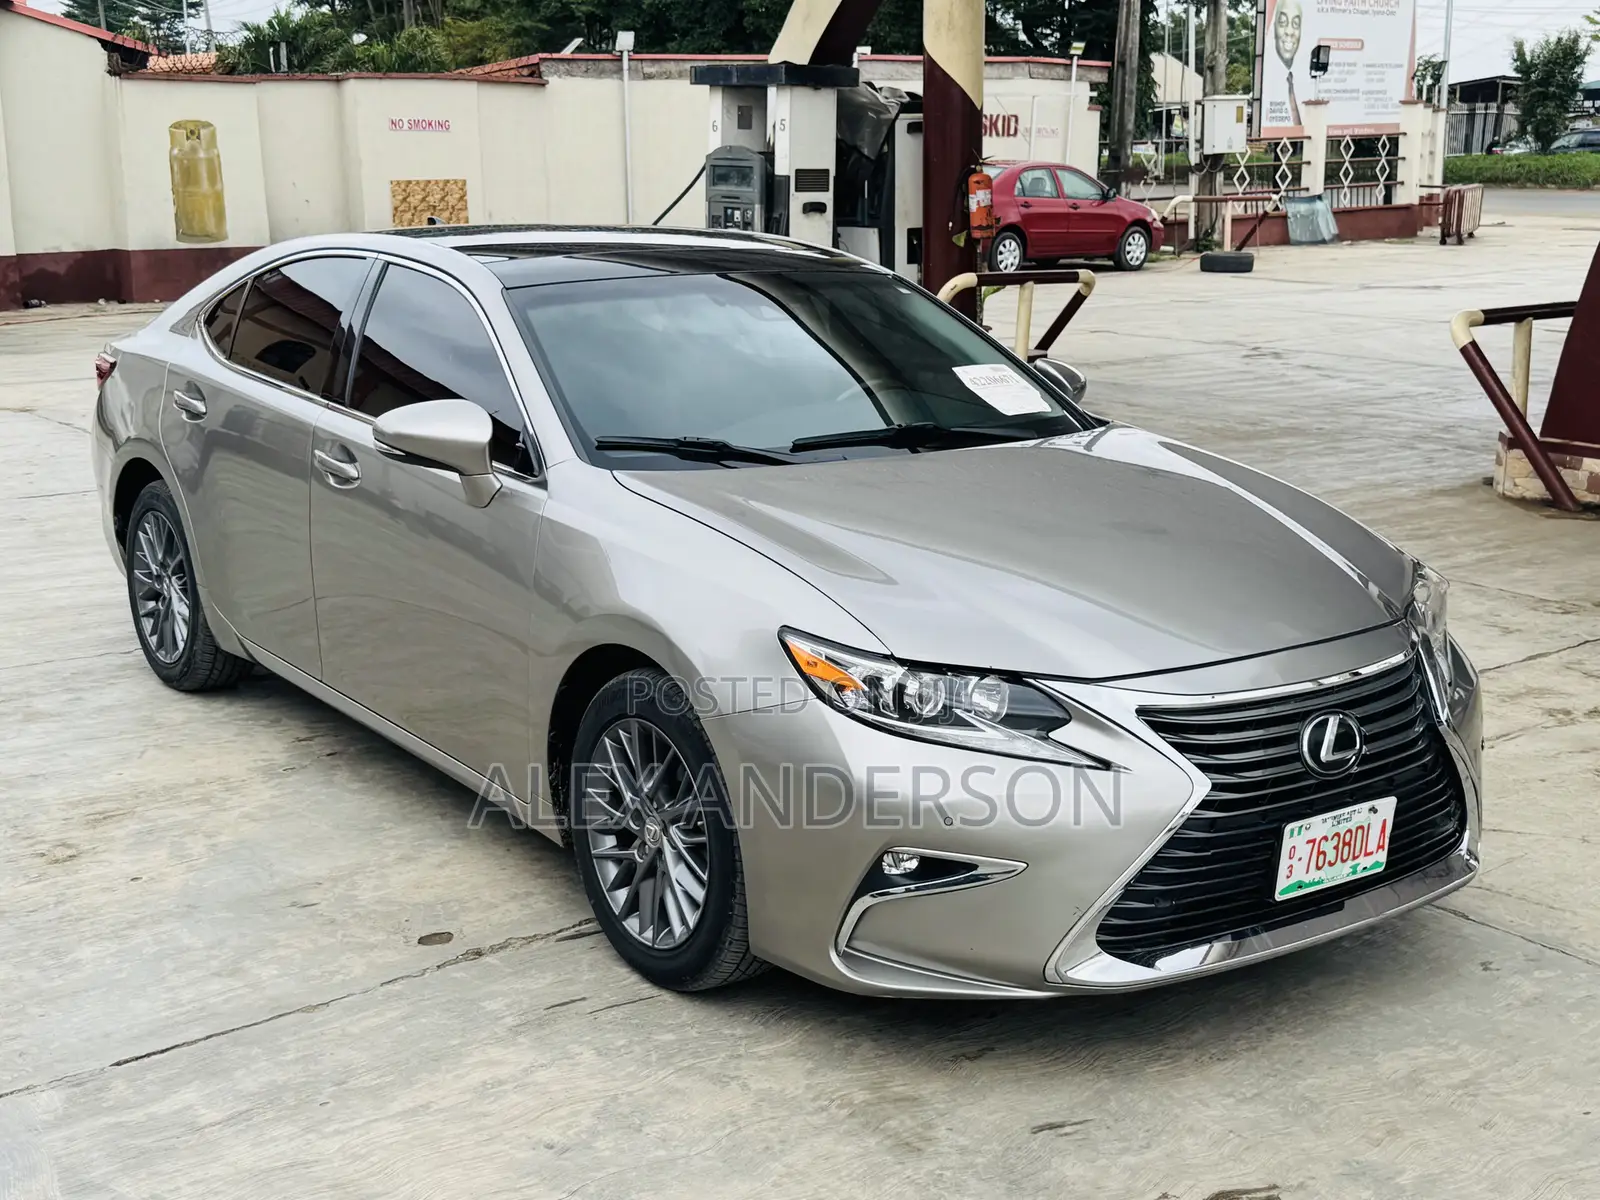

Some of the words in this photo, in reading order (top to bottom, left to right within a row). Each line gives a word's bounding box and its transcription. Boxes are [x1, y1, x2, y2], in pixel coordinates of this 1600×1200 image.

[1369, 0, 1399, 8] CHURCH
[391, 118, 404, 130] NO
[407, 118, 451, 131] SMOKING
[712, 120, 718, 133] 6
[779, 118, 787, 131] 5
